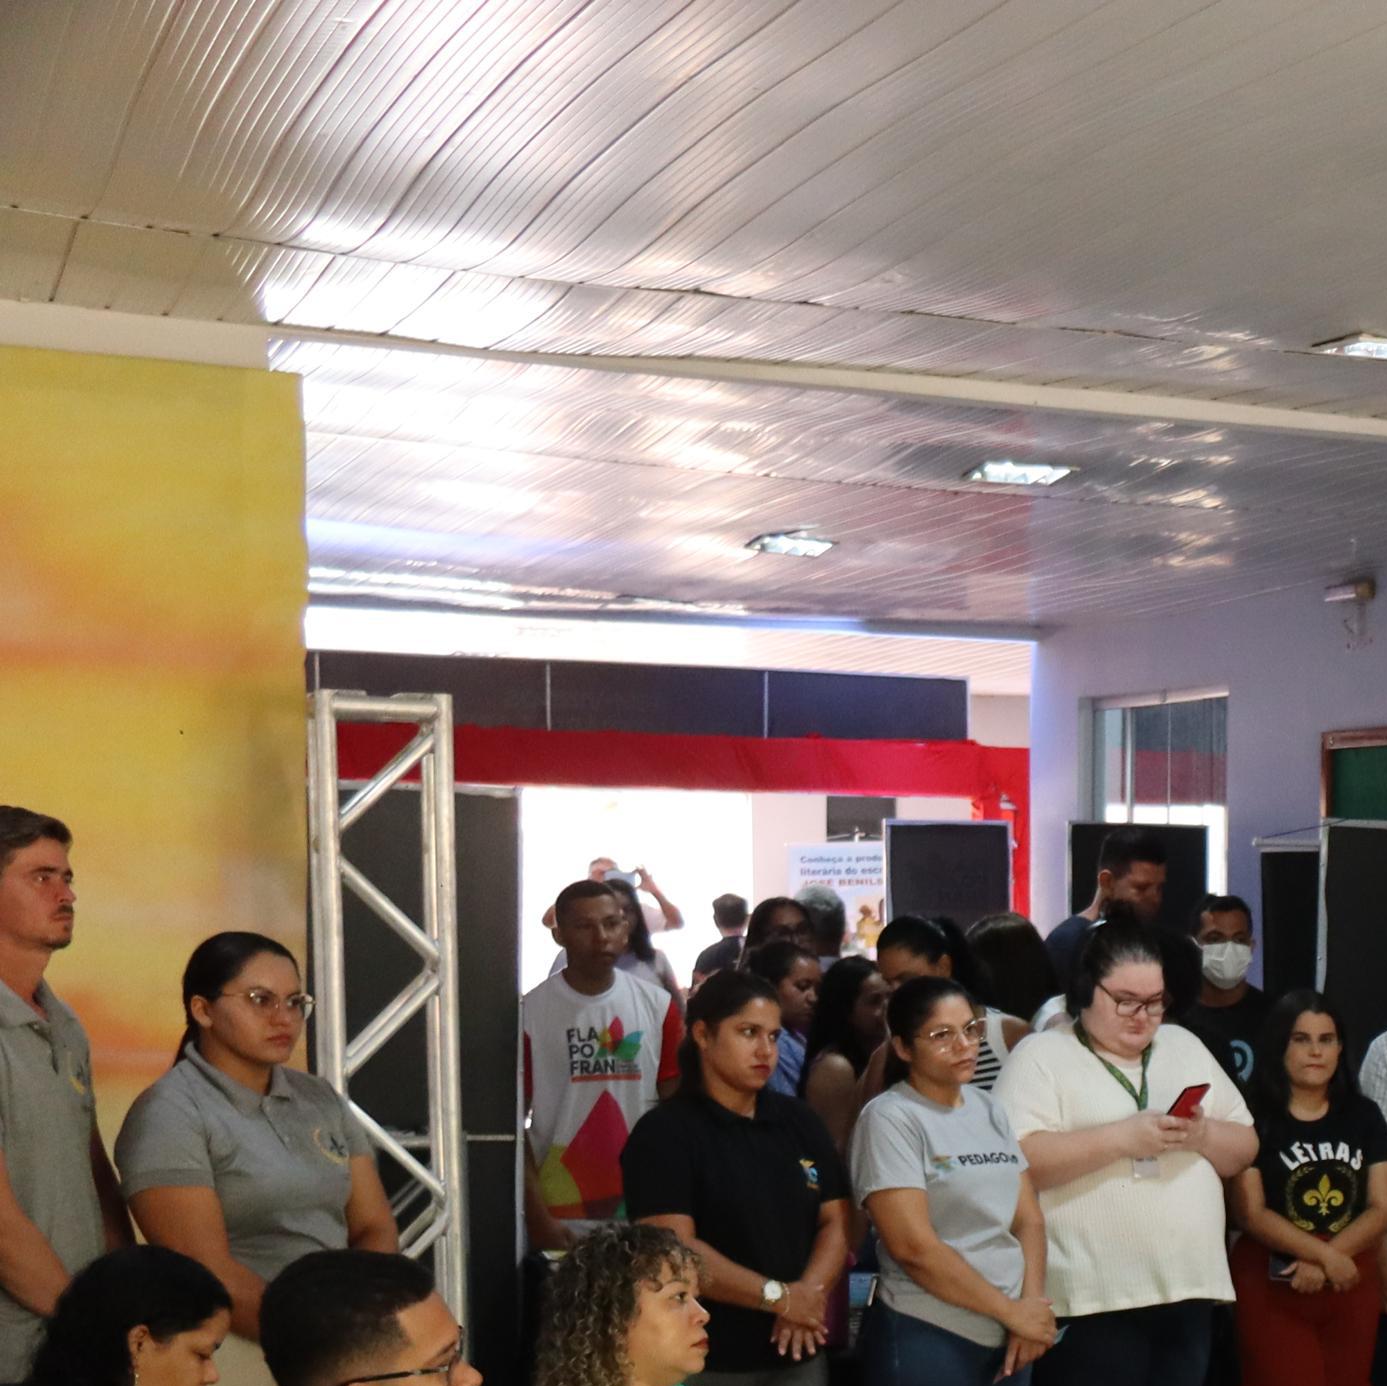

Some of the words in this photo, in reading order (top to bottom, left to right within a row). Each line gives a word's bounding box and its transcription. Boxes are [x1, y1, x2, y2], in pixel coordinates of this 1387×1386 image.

[566, 1027, 600, 1043] FLA
[569, 1043, 594, 1060] PO
[570, 1059, 615, 1076] FRAN
[1279, 1141, 1363, 1171] LETRAS
